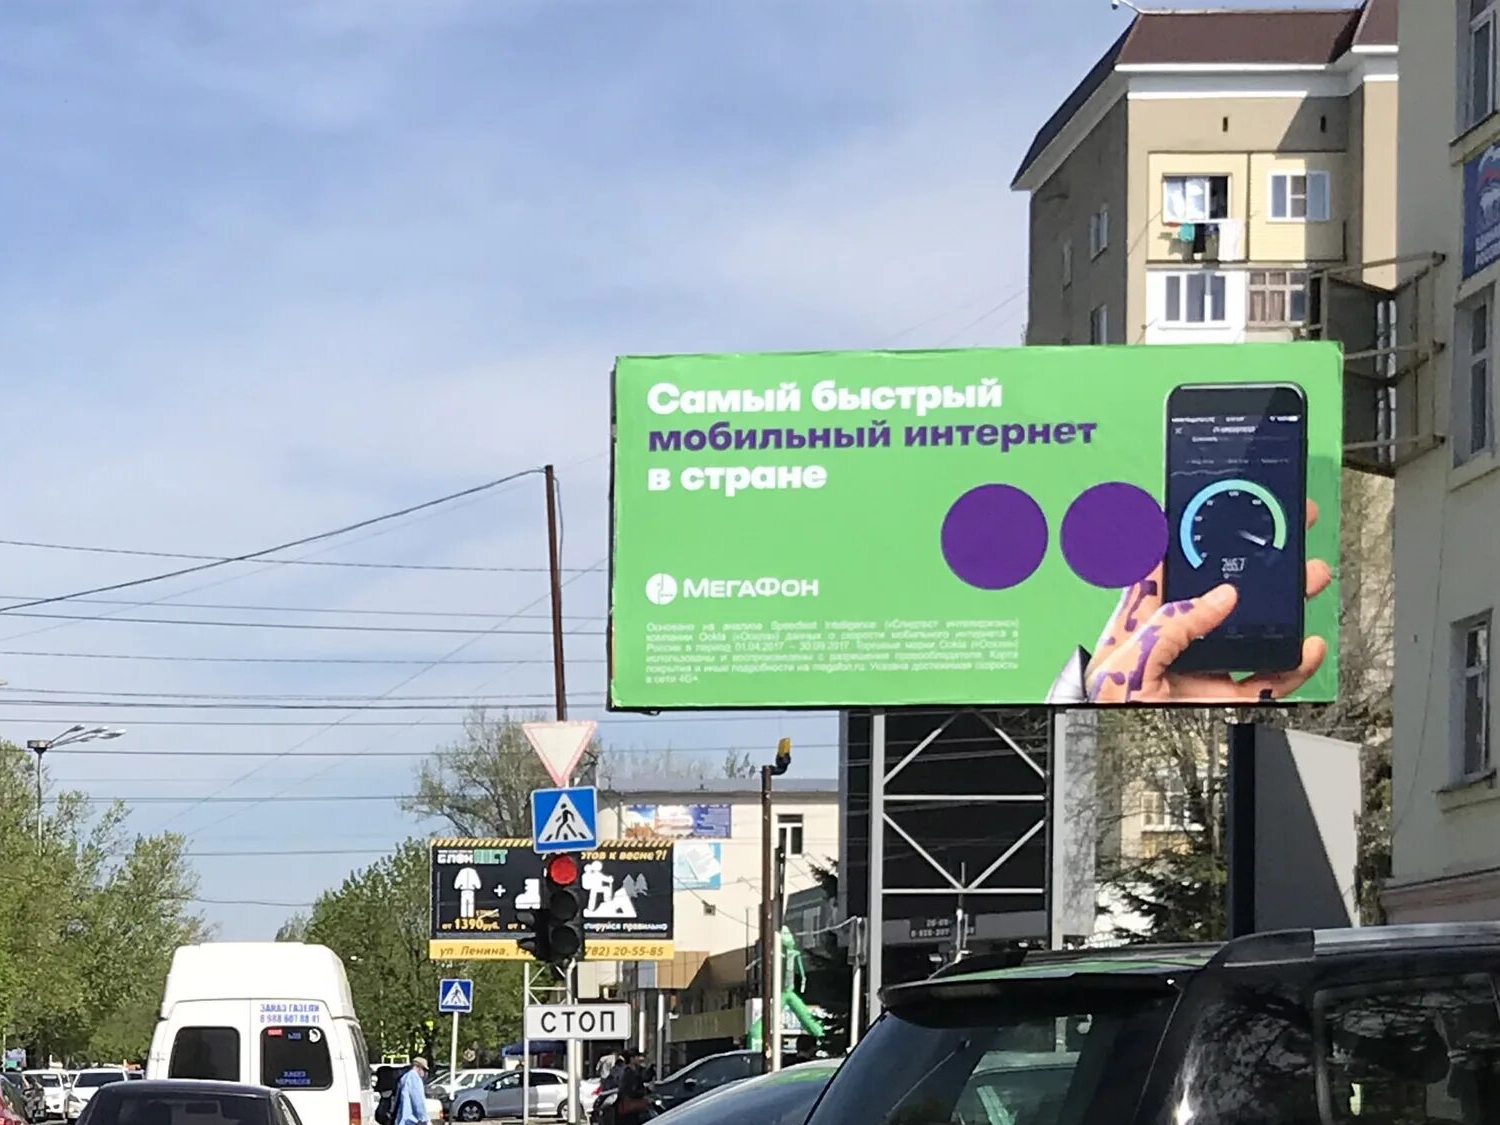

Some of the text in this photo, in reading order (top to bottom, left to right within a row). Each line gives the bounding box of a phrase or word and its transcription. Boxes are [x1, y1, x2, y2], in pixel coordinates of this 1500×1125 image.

[647, 377, 1002, 416] Самый быстрый
[649, 420, 1097, 452] мобильный интернет
[648, 465, 828, 497] в стране
[541, 1011, 615, 1033] СТОП
